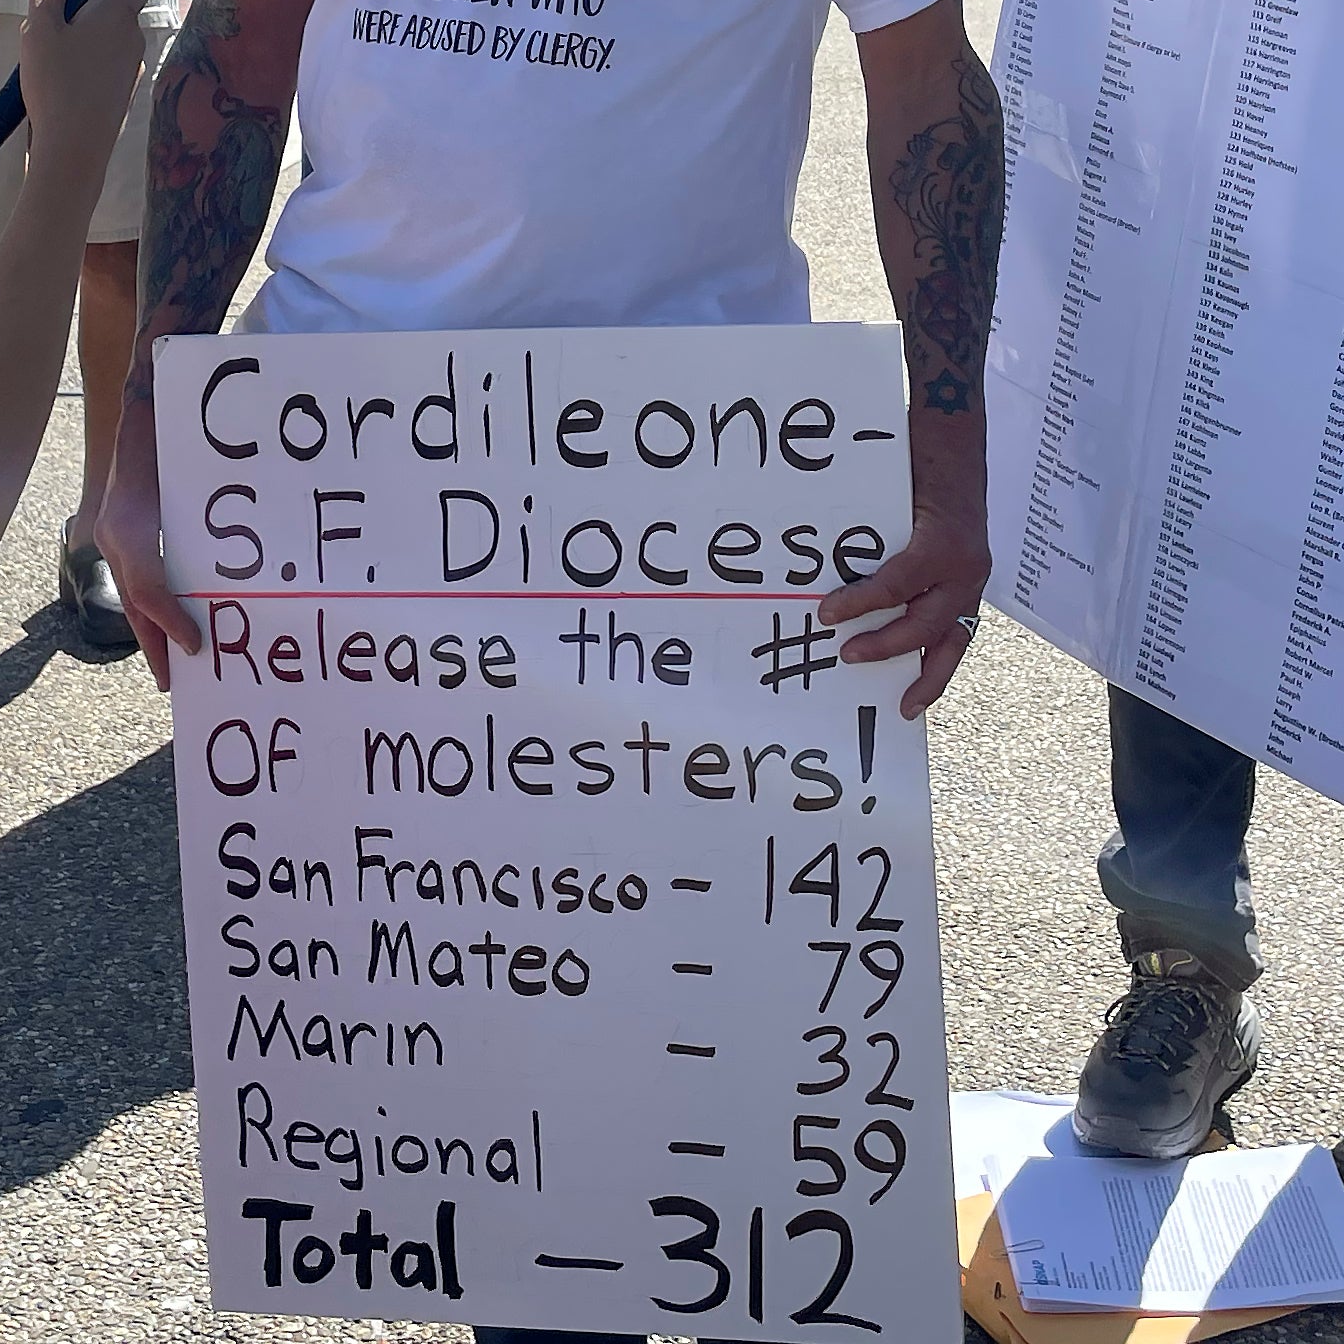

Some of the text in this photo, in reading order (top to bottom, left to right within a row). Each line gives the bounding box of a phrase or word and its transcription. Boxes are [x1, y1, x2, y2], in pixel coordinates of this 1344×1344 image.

[352, 7, 616, 73] WERE ABUSED BY CLERGY.
[204, 483, 886, 589] S.F. Diocese
[209, 599, 517, 689] Release
[558, 607, 693, 686] the
[364, 705, 877, 815] molesters!
[218, 822, 334, 907] San
[354, 827, 648, 914] Francisco
[764, 835, 905, 933] 142
[226, 915, 339, 981] San
[368, 920, 590, 997] Mateo
[807, 939, 905, 1020] 79
[226, 1000, 443, 1067] Marin
[796, 1027, 915, 1112] 32
[237, 1081, 542, 1192] Regional
[792, 1115, 907, 1206] 59
[241, 1198, 465, 1301] Total
[648, 1195, 883, 1335] 312
